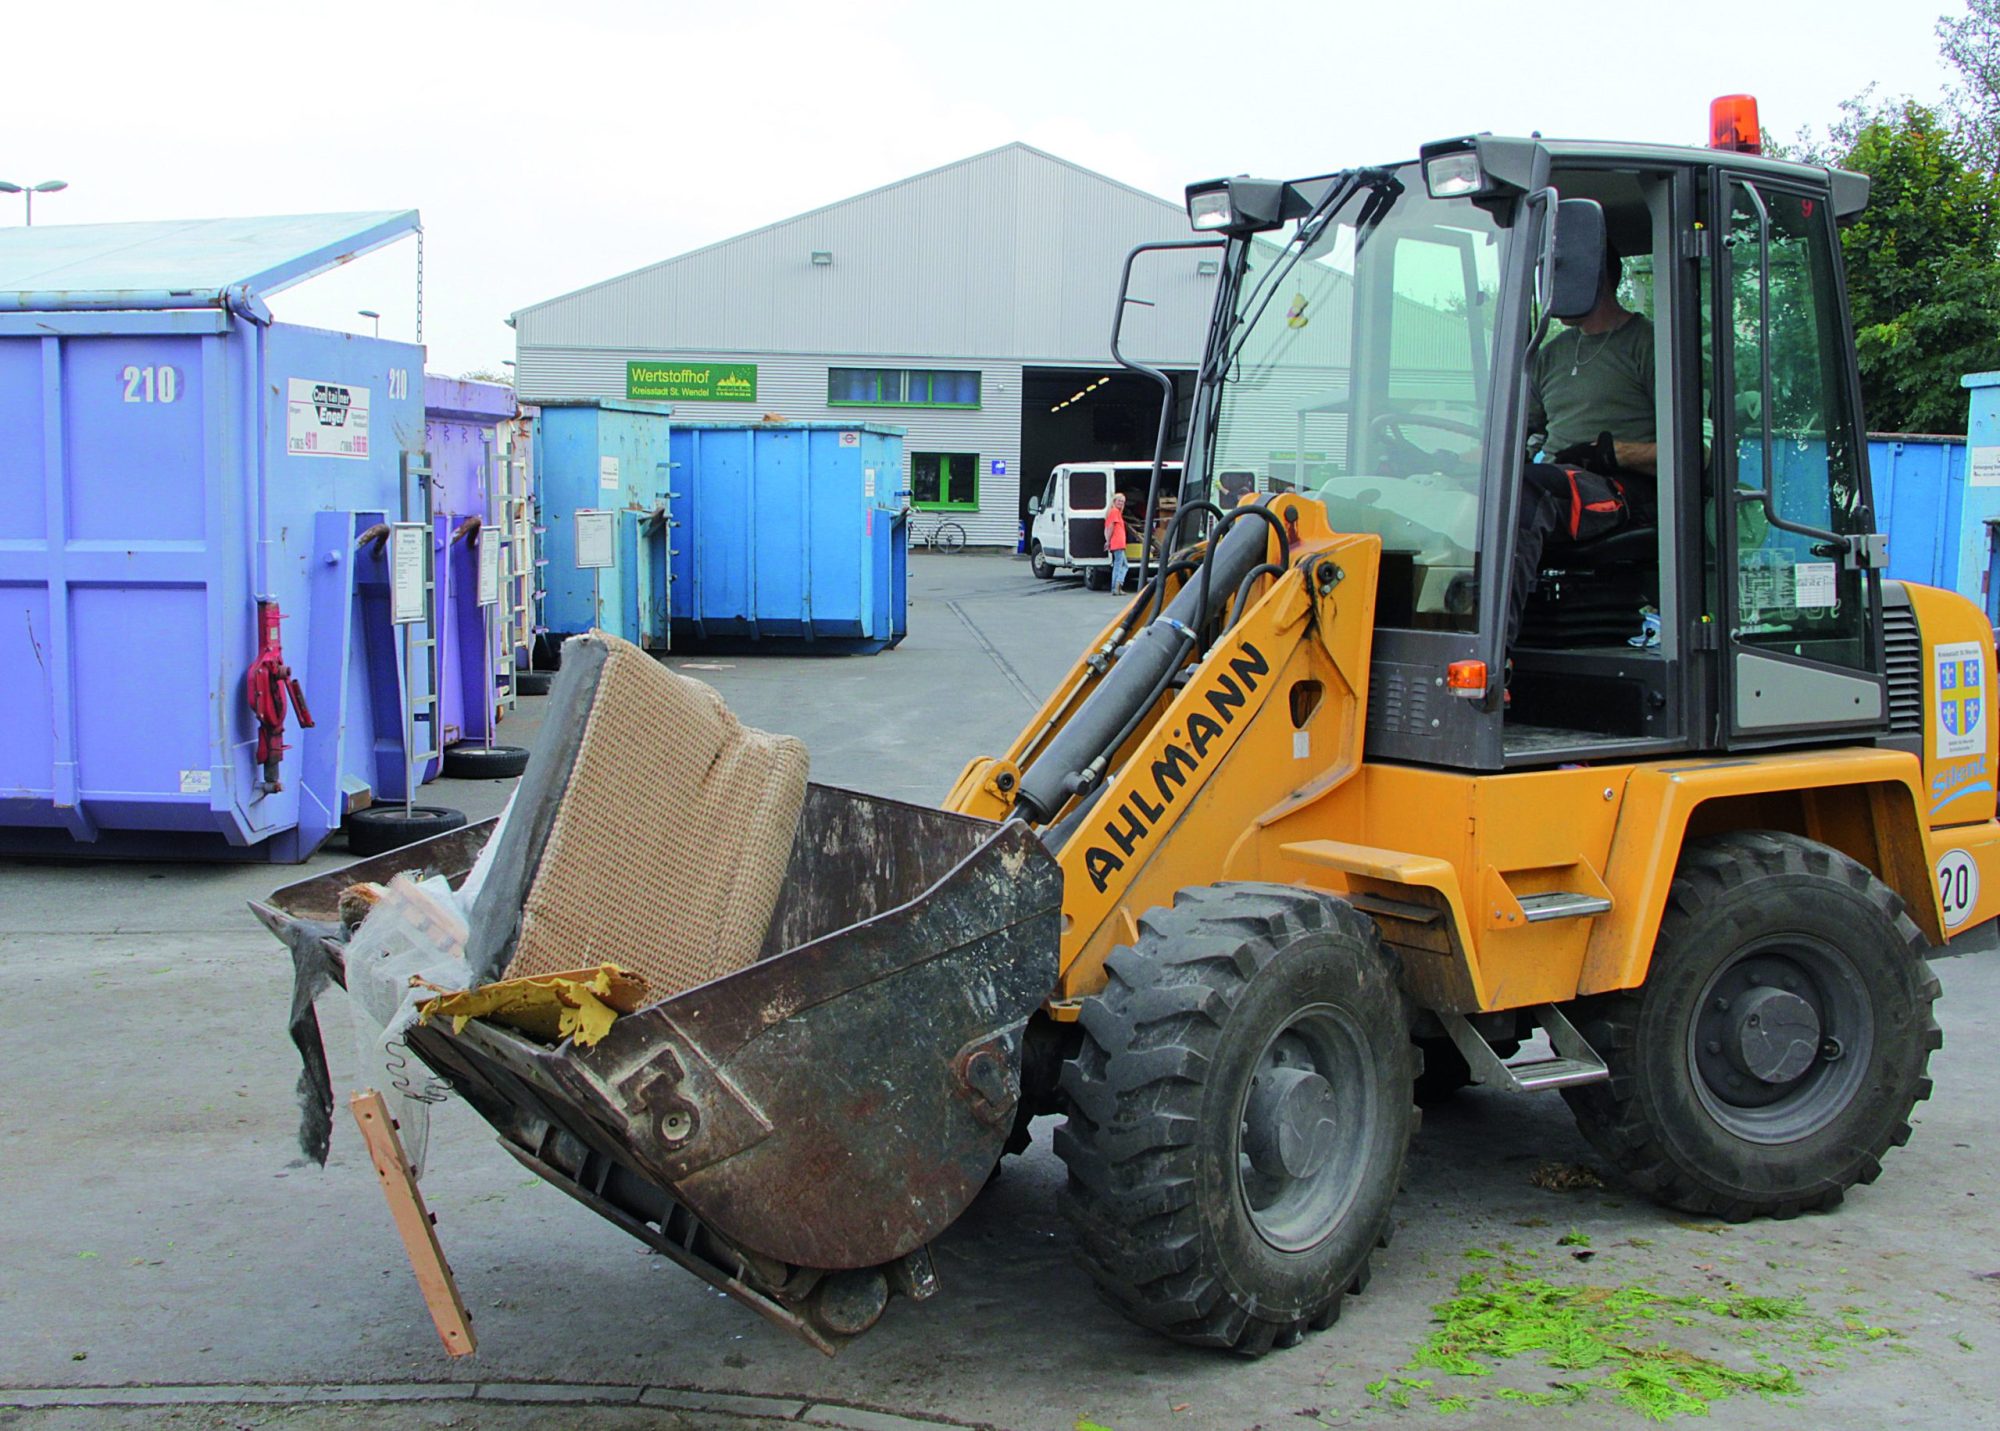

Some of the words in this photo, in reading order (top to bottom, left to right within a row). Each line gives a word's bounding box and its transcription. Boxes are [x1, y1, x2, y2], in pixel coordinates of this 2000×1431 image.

[123, 366, 176, 403] 210
[388, 367, 408, 400] 210
[631, 368, 711, 384] Wertstoffhof
[631, 386, 669, 396] Kreisstadt
[670, 387, 680, 396] St.
[681, 387, 710, 397] Wendel
[313, 388, 350, 402] Container
[320, 406, 346, 426] Engel
[1085, 641, 1270, 894] AHLMANN
[1931, 753, 1988, 800] Silent
[1940, 864, 1968, 913] 20
